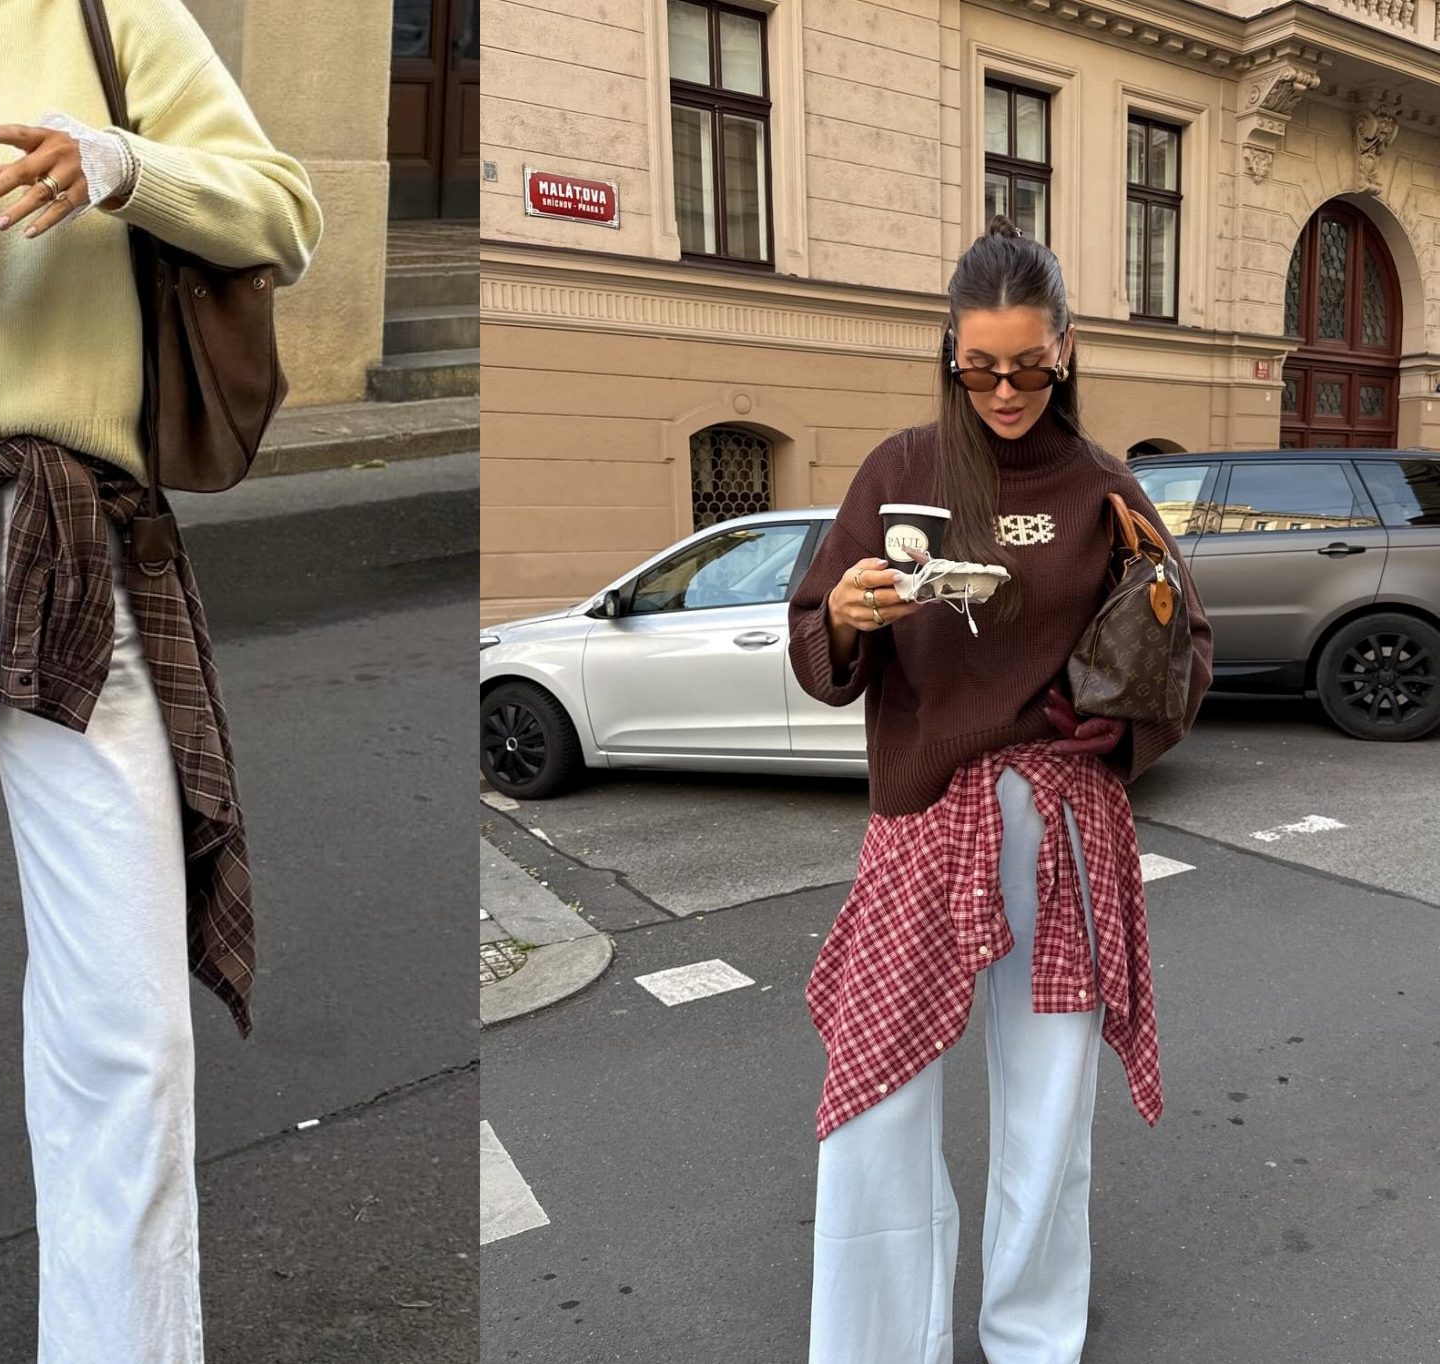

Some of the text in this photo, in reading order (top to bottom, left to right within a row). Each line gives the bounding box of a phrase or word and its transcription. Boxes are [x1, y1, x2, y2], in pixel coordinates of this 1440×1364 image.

[539, 181, 606, 204] MALÁTOVA
[542, 197, 572, 209] SMÍCHOV
[578, 203, 599, 213] PRAHA
[888, 537, 923, 548] PAUL
